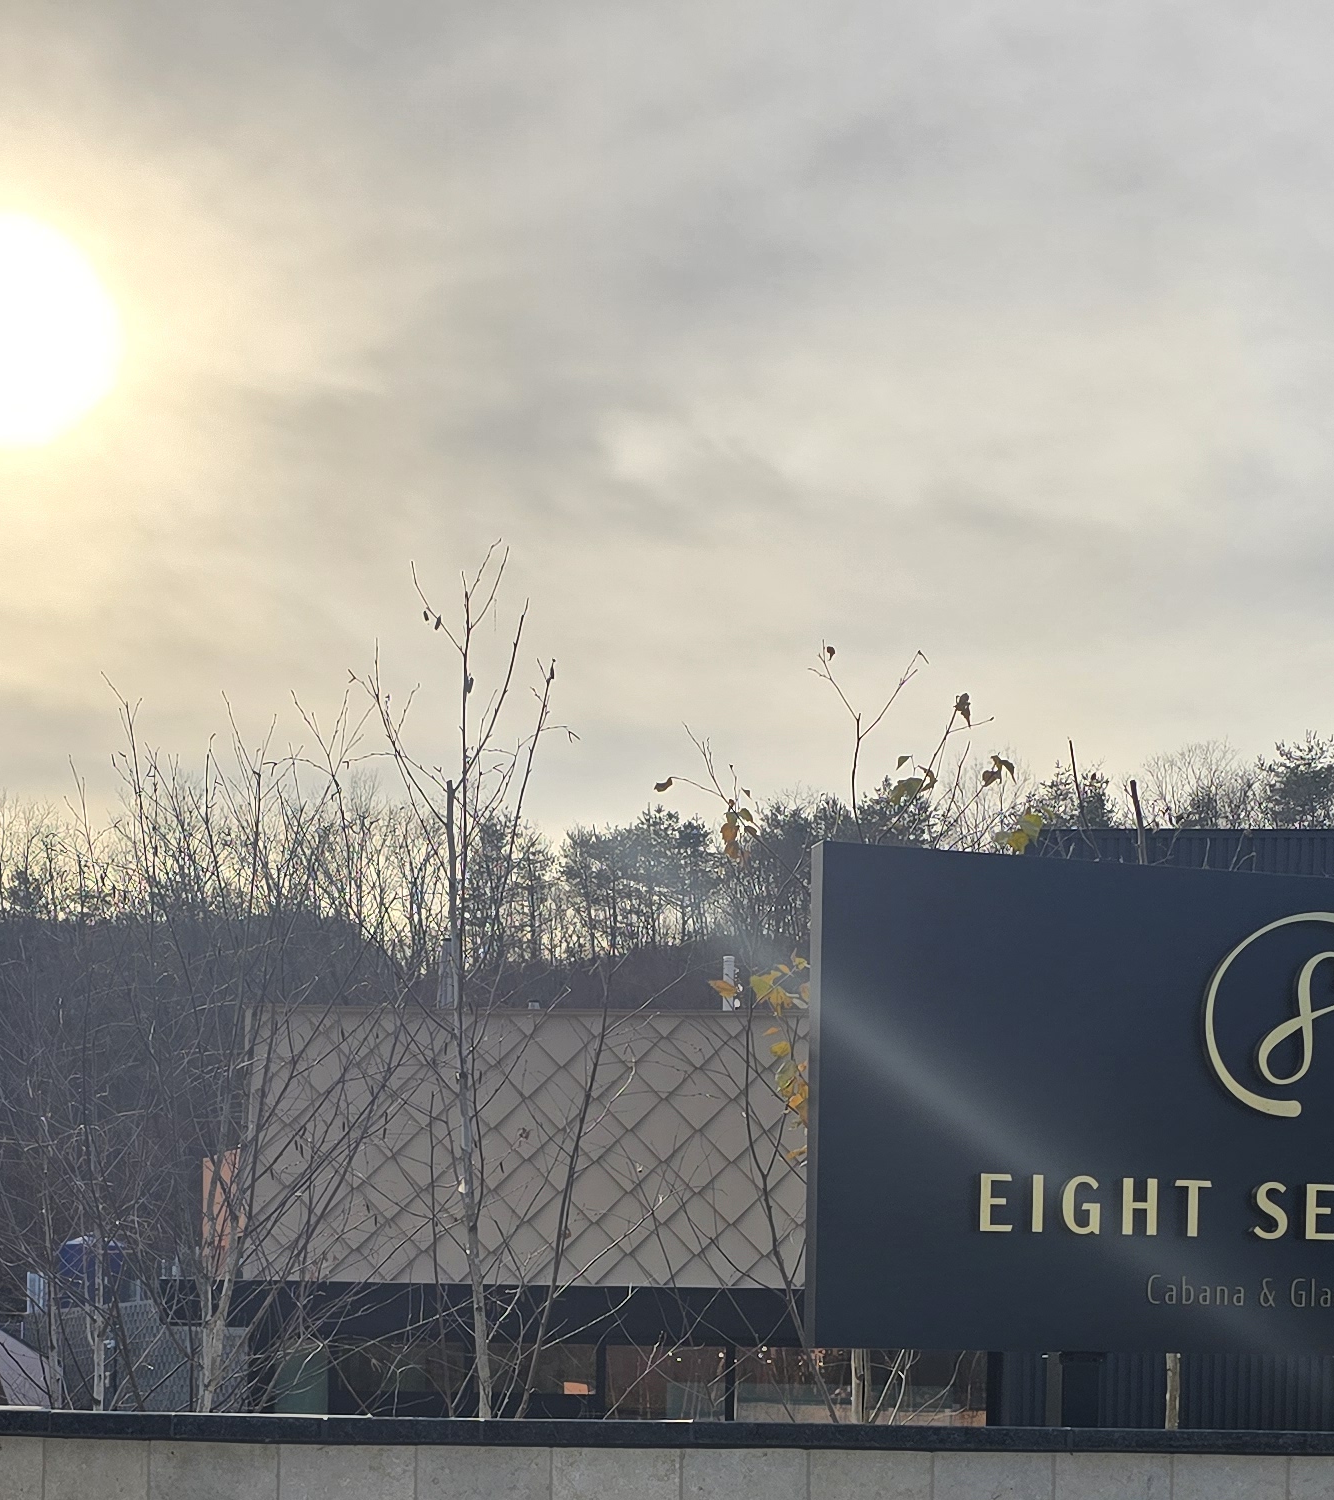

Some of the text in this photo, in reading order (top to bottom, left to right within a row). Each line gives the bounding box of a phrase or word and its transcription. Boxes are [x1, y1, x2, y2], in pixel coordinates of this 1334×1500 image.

[979, 1172, 1213, 1238] EIGHT
[1146, 1273, 1245, 1307] Cabana
[1259, 1277, 1277, 1308] &
